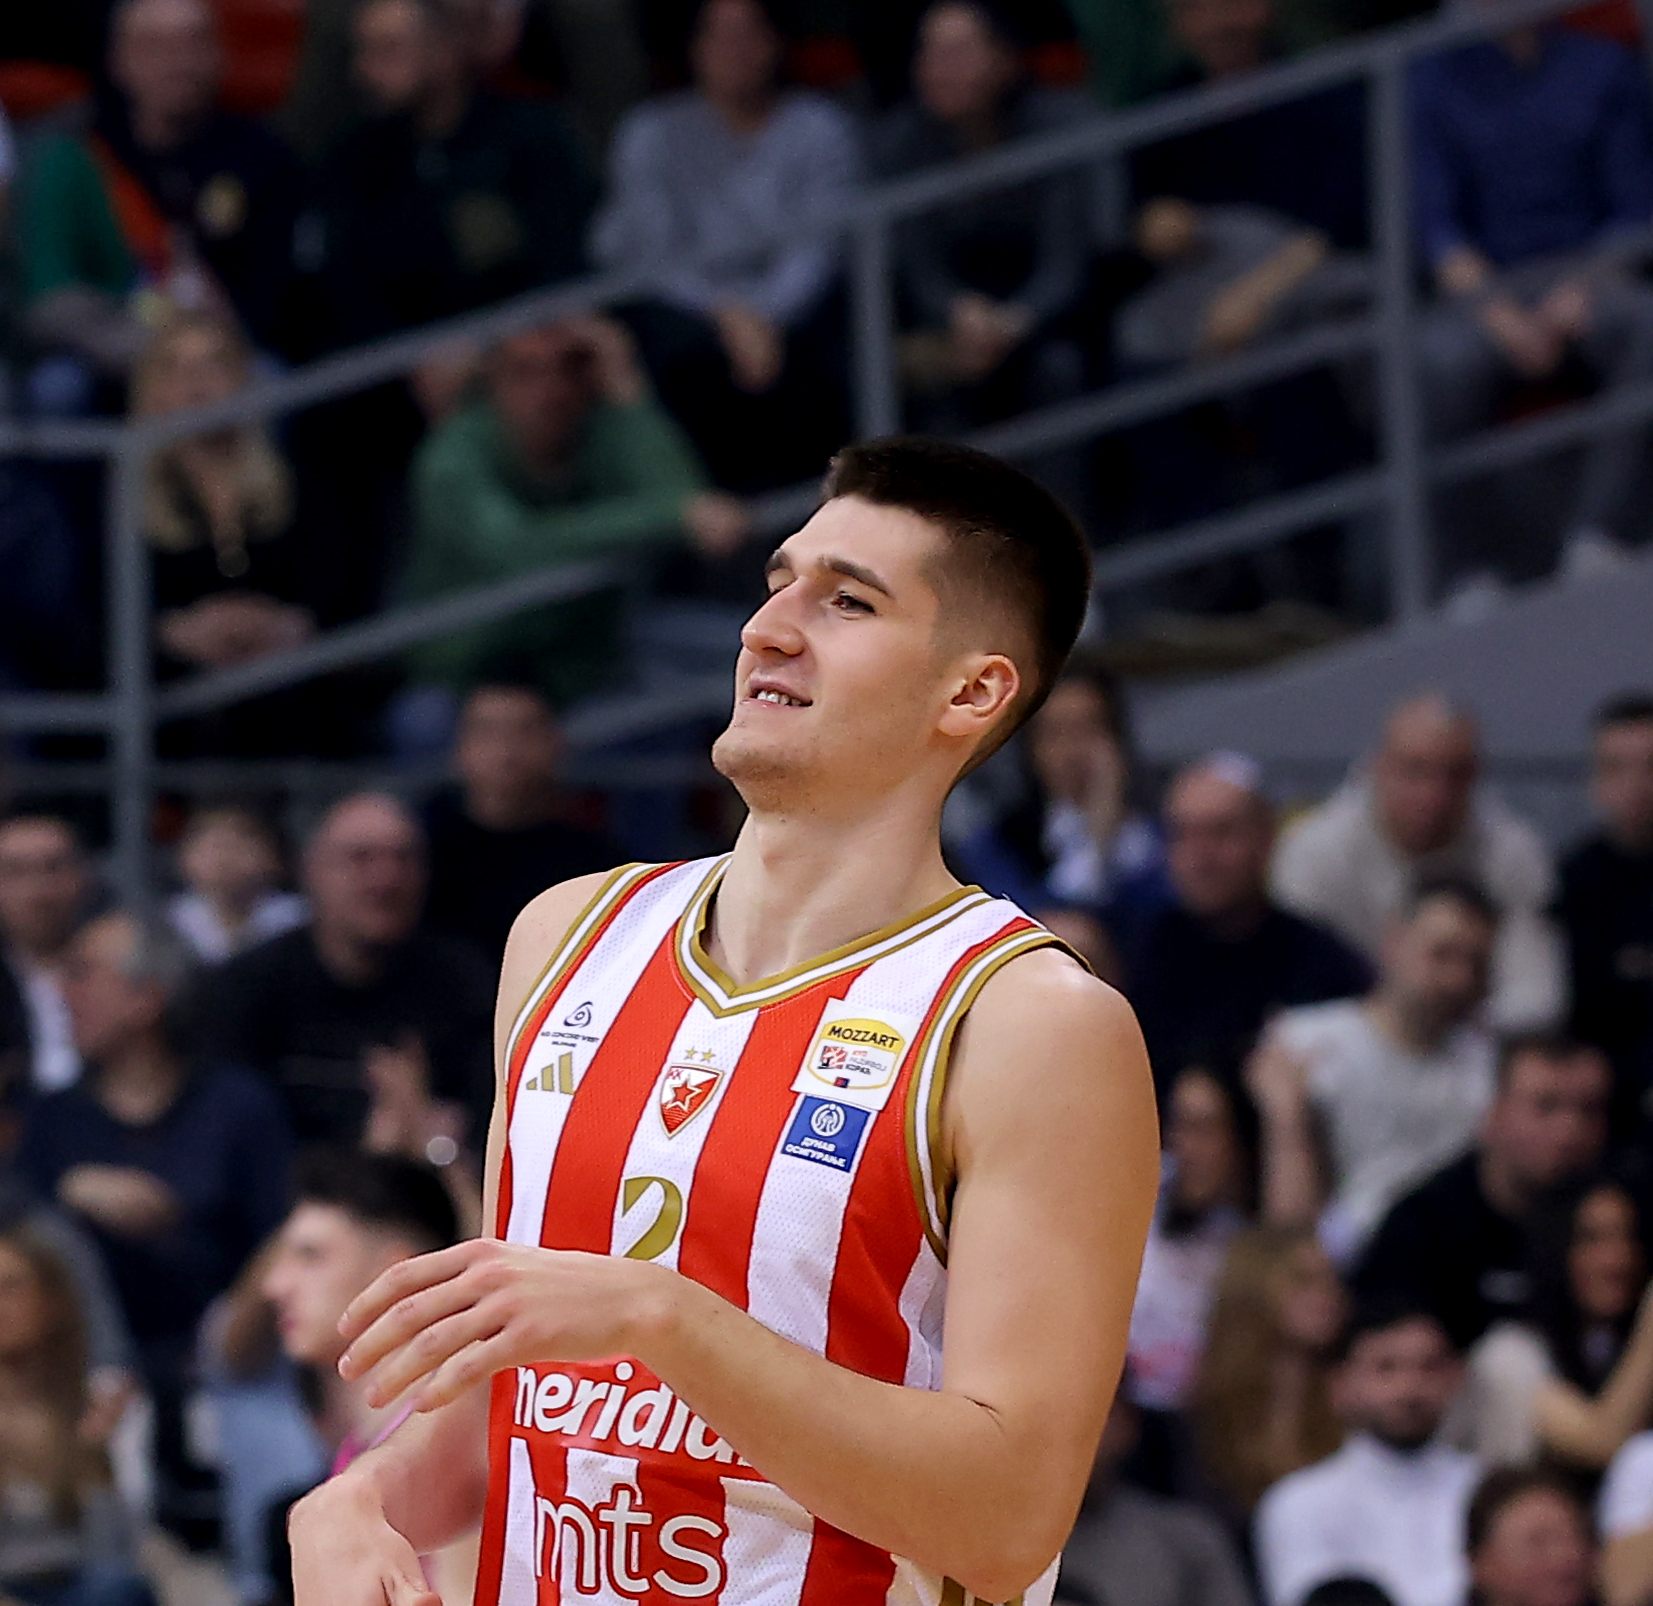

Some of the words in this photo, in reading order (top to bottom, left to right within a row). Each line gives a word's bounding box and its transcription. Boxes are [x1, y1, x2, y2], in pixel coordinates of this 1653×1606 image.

[828, 1025, 900, 1048] MOZZART
[621, 1175, 684, 1260] 2
[536, 1486, 724, 1598] mts
